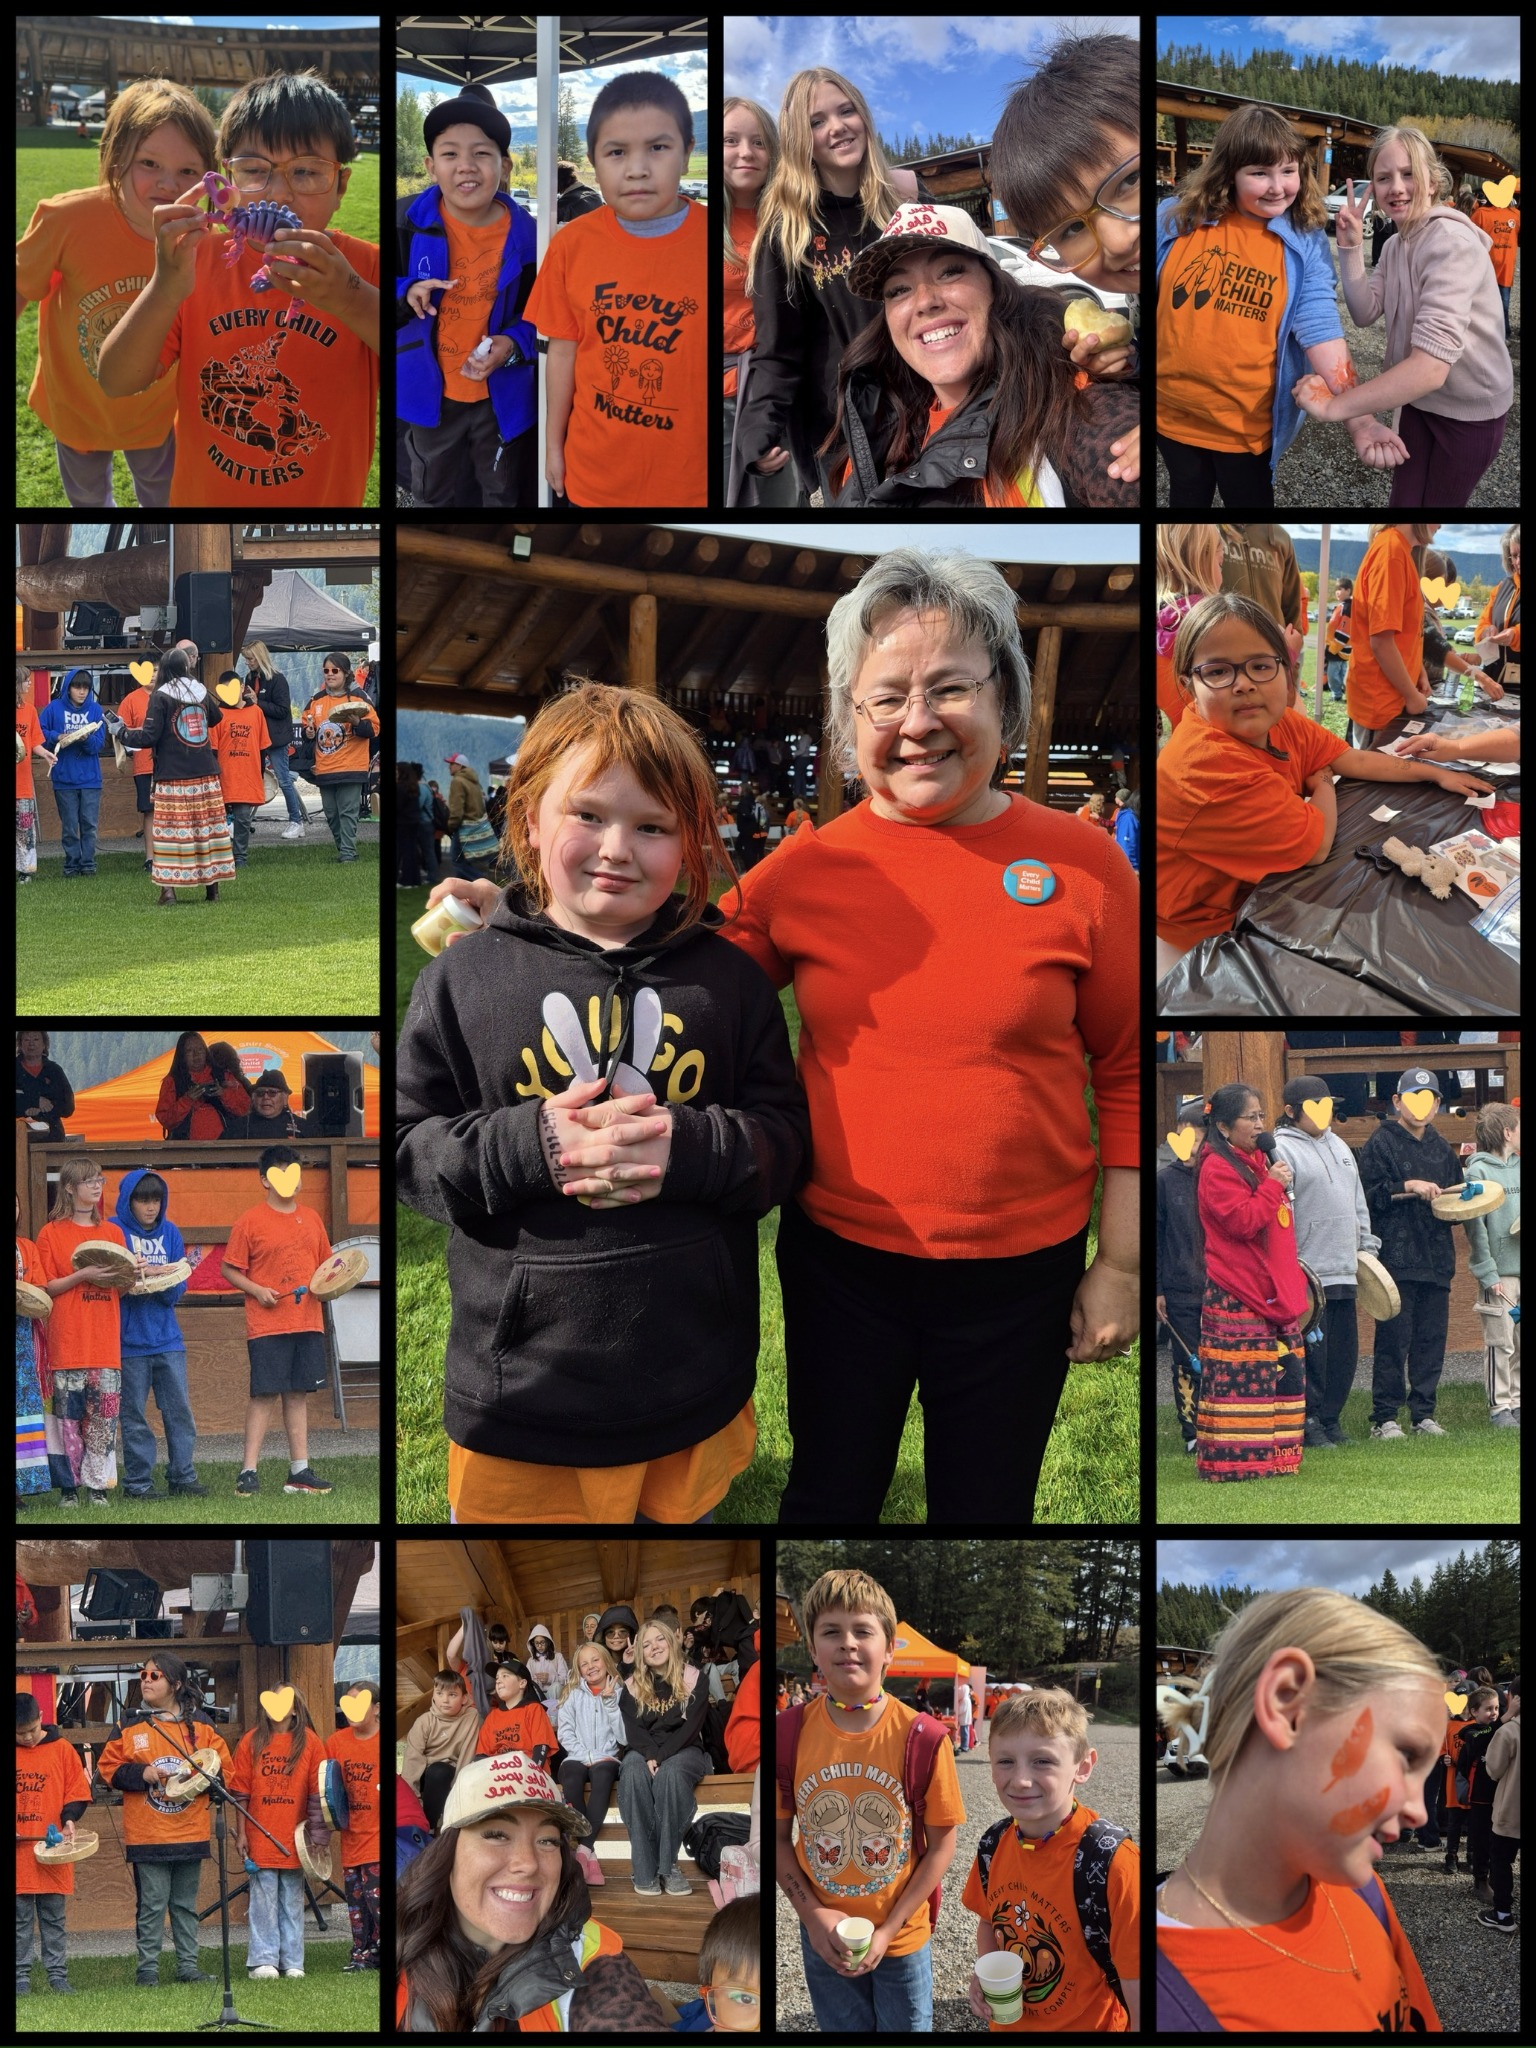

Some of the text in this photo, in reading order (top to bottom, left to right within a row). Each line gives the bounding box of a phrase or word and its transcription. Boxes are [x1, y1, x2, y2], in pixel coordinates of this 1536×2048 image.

[1224, 261, 1278, 291] EVERY
[78, 285, 112, 314] EVERY
[594, 281, 685, 327] Every
[1219, 278, 1273, 309] CHILD
[1213, 298, 1268, 323] MATTERS
[208, 308, 338, 348] EVERY CHILD
[596, 315, 684, 354] Child
[594, 392, 674, 431] Matters
[207, 443, 304, 487] MATTERS
[64, 711, 90, 725] FOX
[1019, 883, 1041, 892] Matters
[1020, 877, 1041, 885] Child
[1022, 870, 1040, 880] Every
[343, 1759, 374, 1773] Every
[345, 1771, 373, 1783] Child
[819, 1762, 863, 1782] CHILD
[16, 1781, 45, 1793] Child
[261, 1796, 295, 1806] Matters
[1030, 1890, 1072, 1934] MATTERS
[1044, 1980, 1076, 2016] COMPTE
